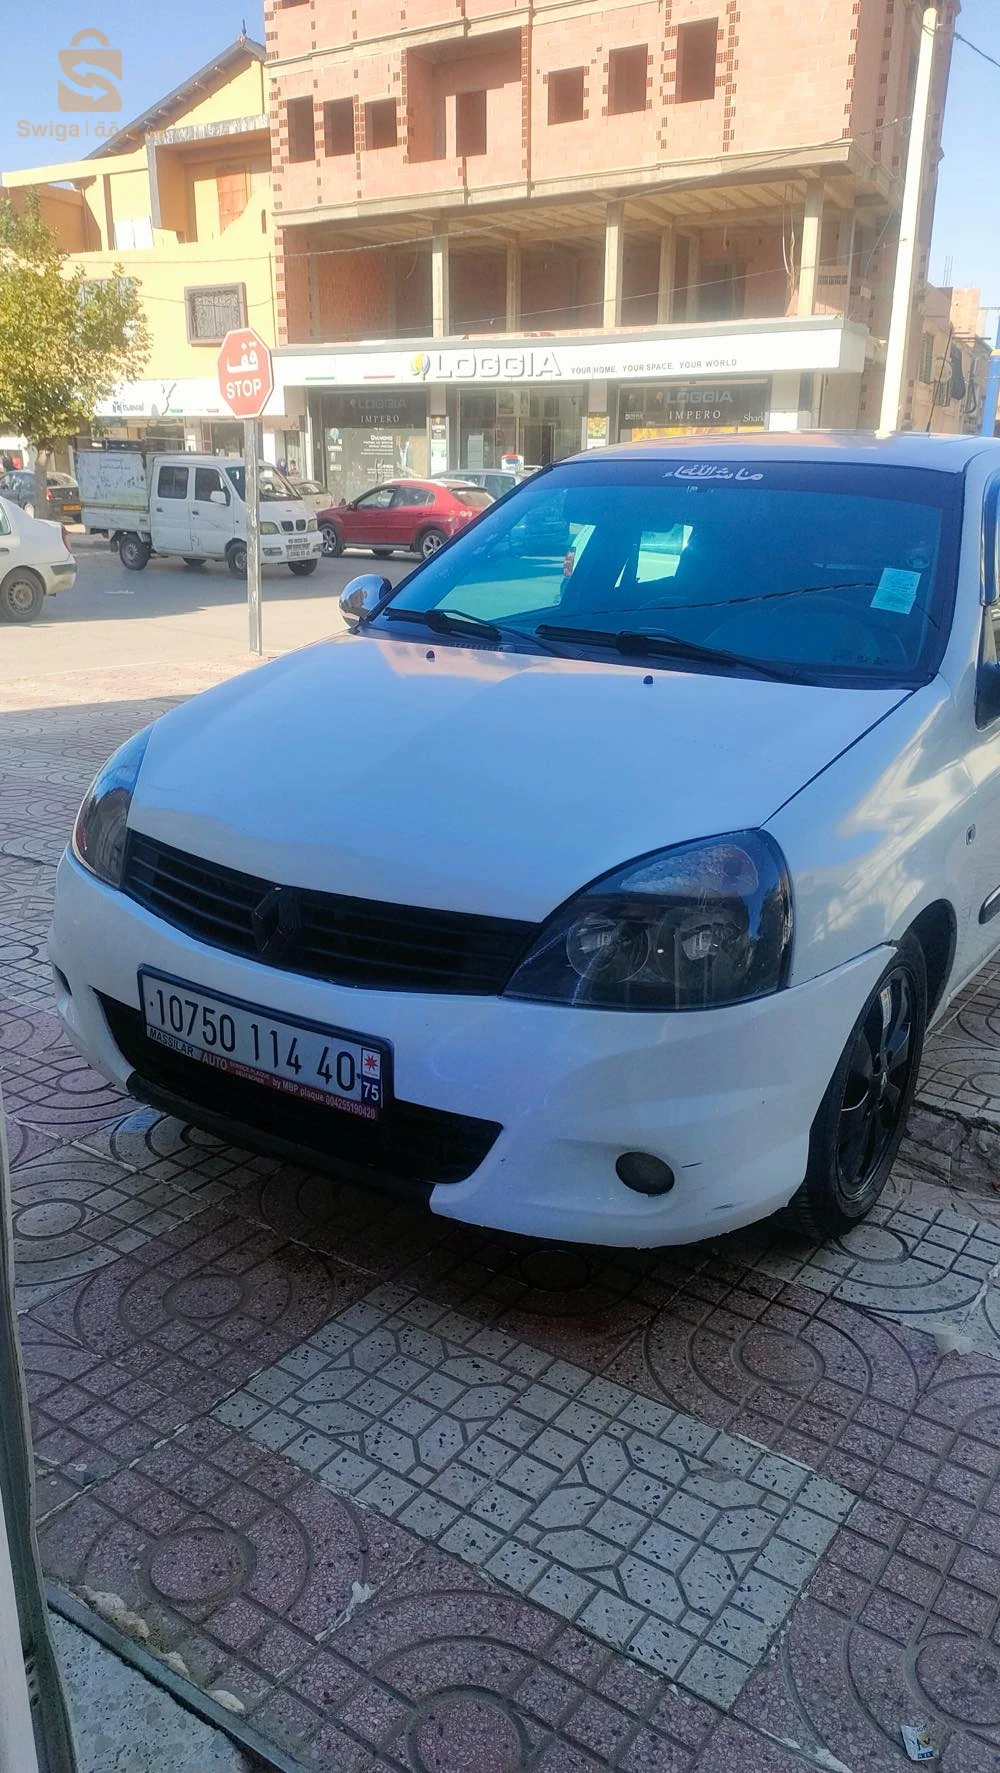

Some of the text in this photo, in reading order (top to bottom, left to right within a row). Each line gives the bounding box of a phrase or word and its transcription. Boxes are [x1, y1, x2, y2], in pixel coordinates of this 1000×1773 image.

[225, 340, 260, 374] قف
[436, 352, 562, 379] LOGGIA
[571, 367, 592, 375] YOUR
[622, 364, 644, 372] YOUR
[679, 360, 701, 369] YOUR
[705, 358, 737, 367] WORLD
[226, 378, 262, 399] STOP
[667, 391, 734, 403] LOGGIA
[361, 415, 400, 423] IMPERO
[669, 410, 721, 420] IMPERO
[156, 989, 355, 1091] 10750 114 40
[150, 1028, 194, 1057] MASSILAR
[202, 1053, 228, 1071] AUTO
[272, 1078, 282, 1088] by
[363, 1081, 379, 1101] 75
